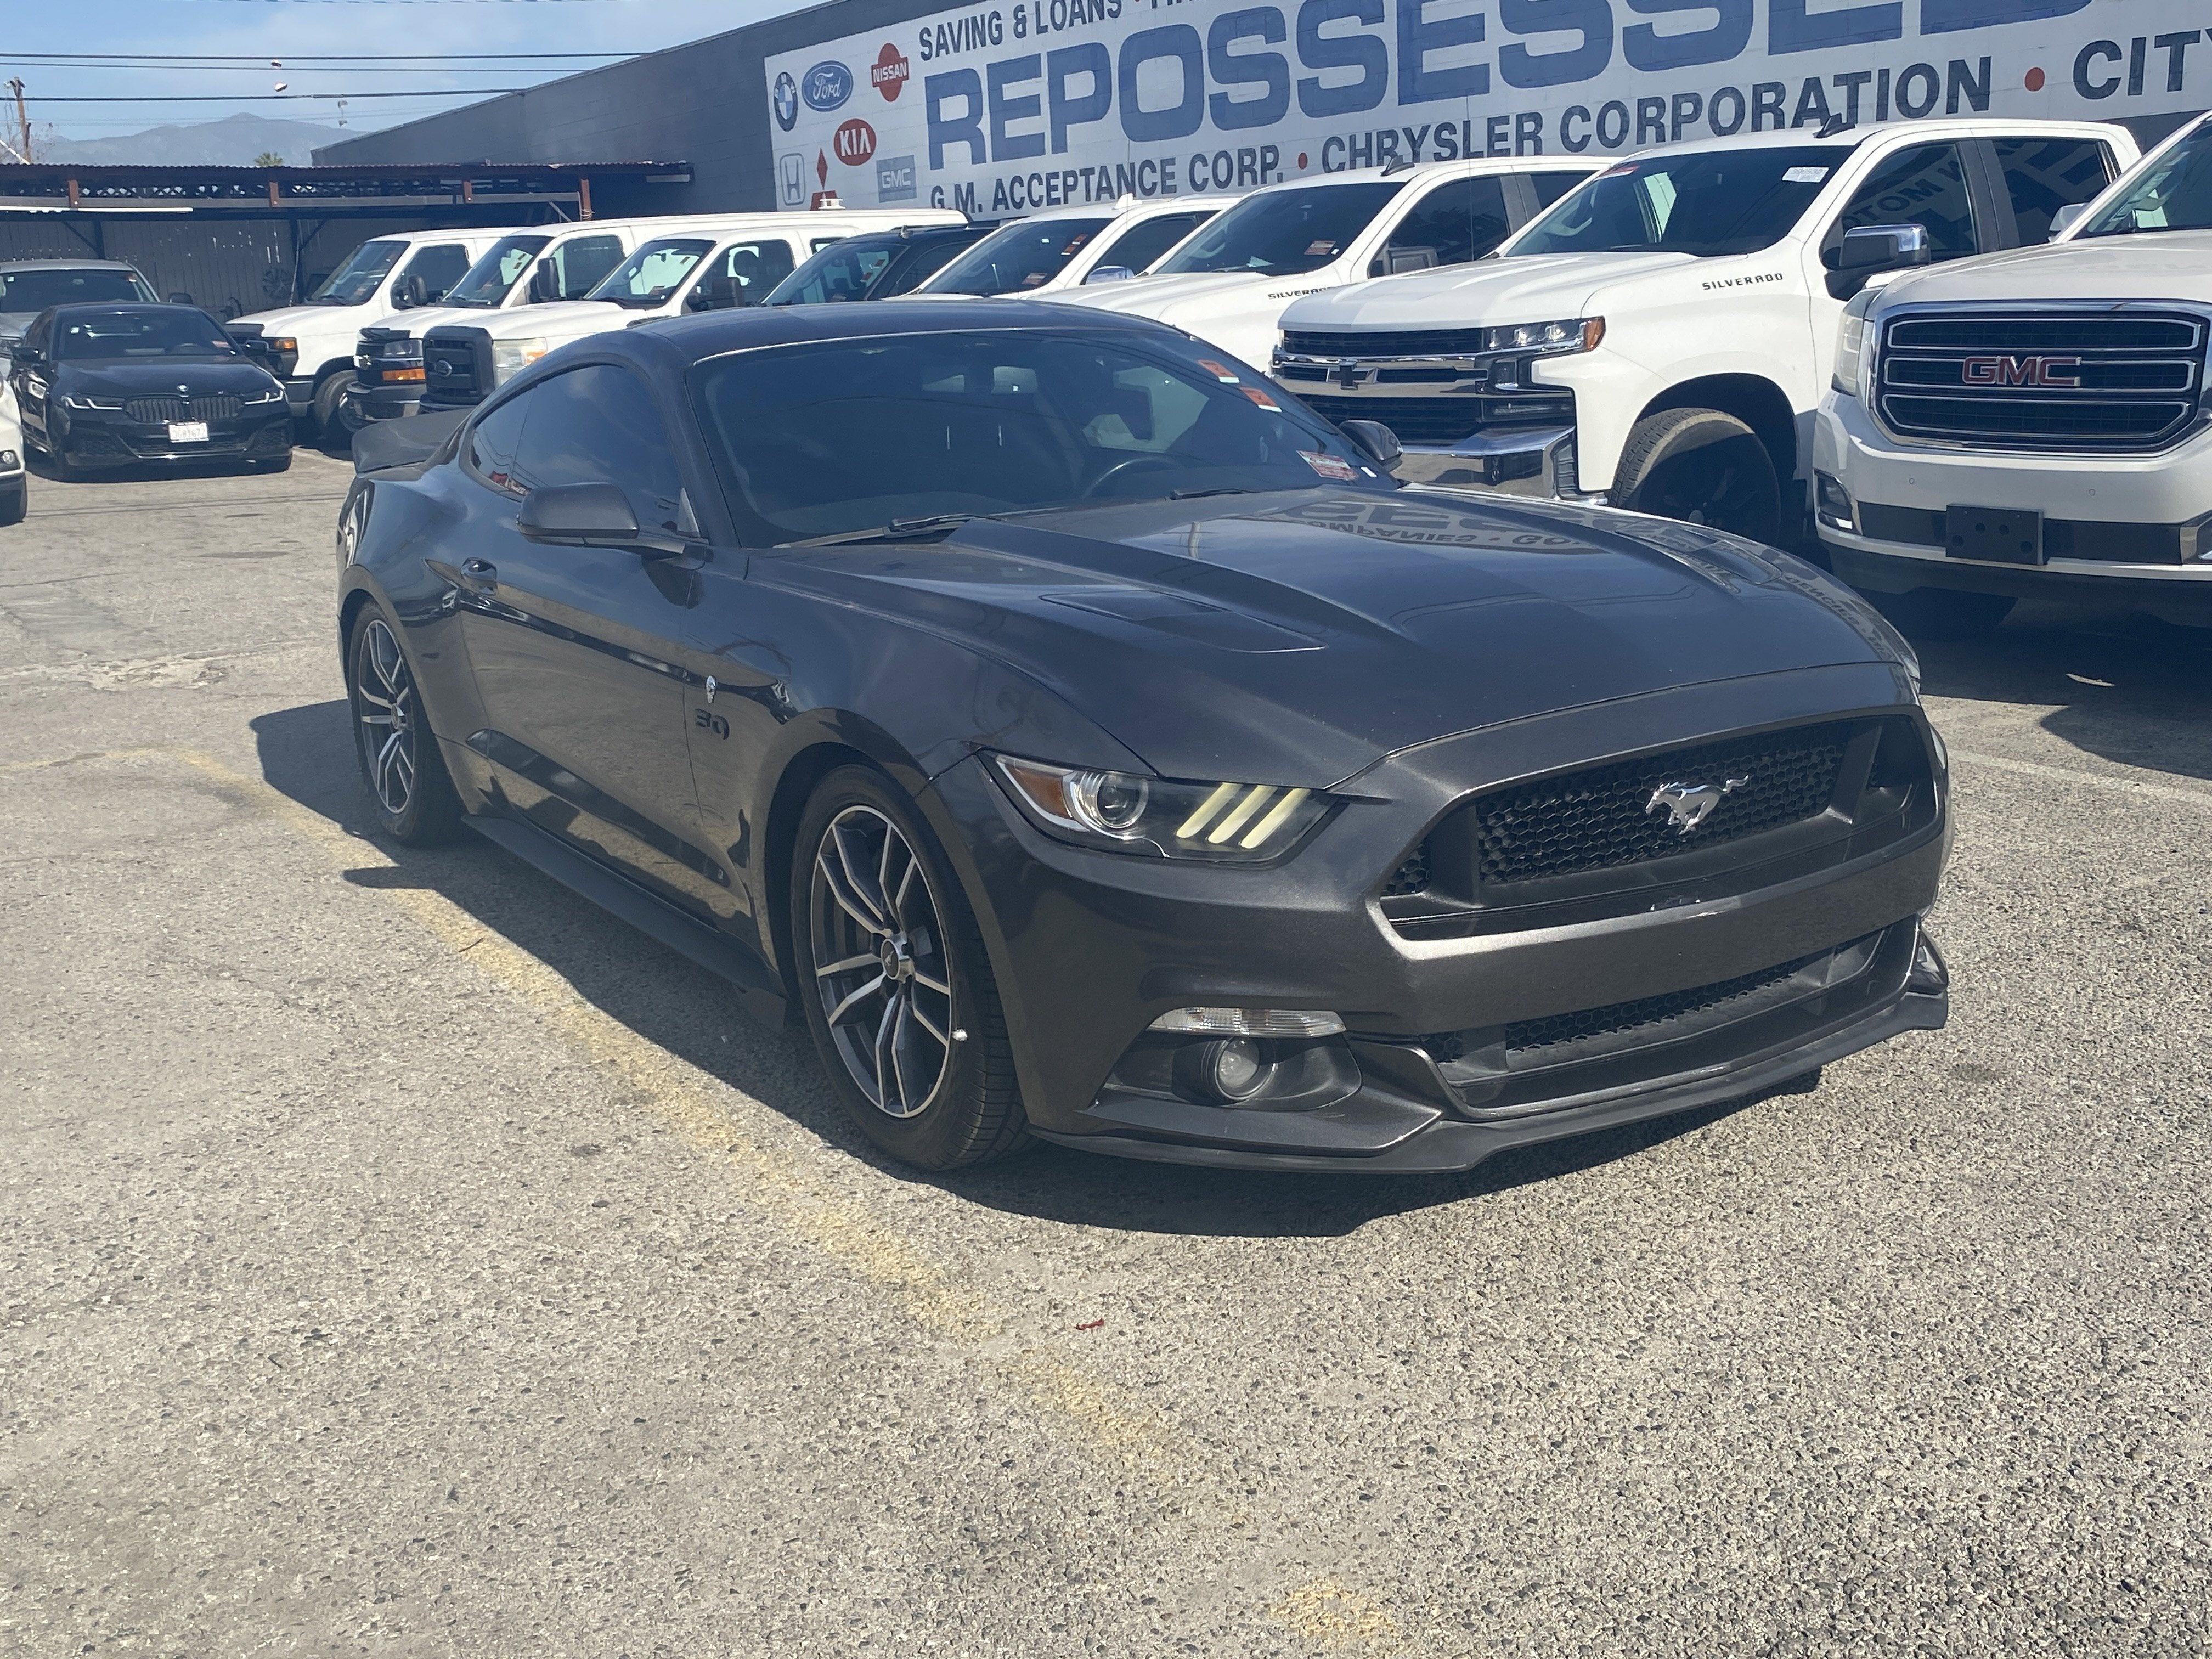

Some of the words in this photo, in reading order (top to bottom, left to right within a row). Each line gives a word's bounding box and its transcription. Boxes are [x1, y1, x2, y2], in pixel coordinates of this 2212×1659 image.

[919, 11, 1003, 61] SAVING
[1013, 4, 1026, 39] &
[1035, 0, 1122, 35] LOANS
[813, 72, 842, 100] Ford
[873, 62, 907, 83] NISSAN
[924, 0, 2087, 171] REPOSSES
[992, 157, 1177, 211] ACCEPTANCE
[1189, 144, 1283, 192] CORP.
[1322, 111, 1543, 174] CHRYSLER
[1560, 56, 1991, 154] CORPORATION
[2073, 29, 2212, 100] CIT
[839, 127, 872, 157] KIA
[881, 168, 911, 189] GMC
[1268, 286, 1335, 300] SILVERA
[1702, 273, 1784, 290] SILVERADO
[1962, 356, 2083, 388] GMC
